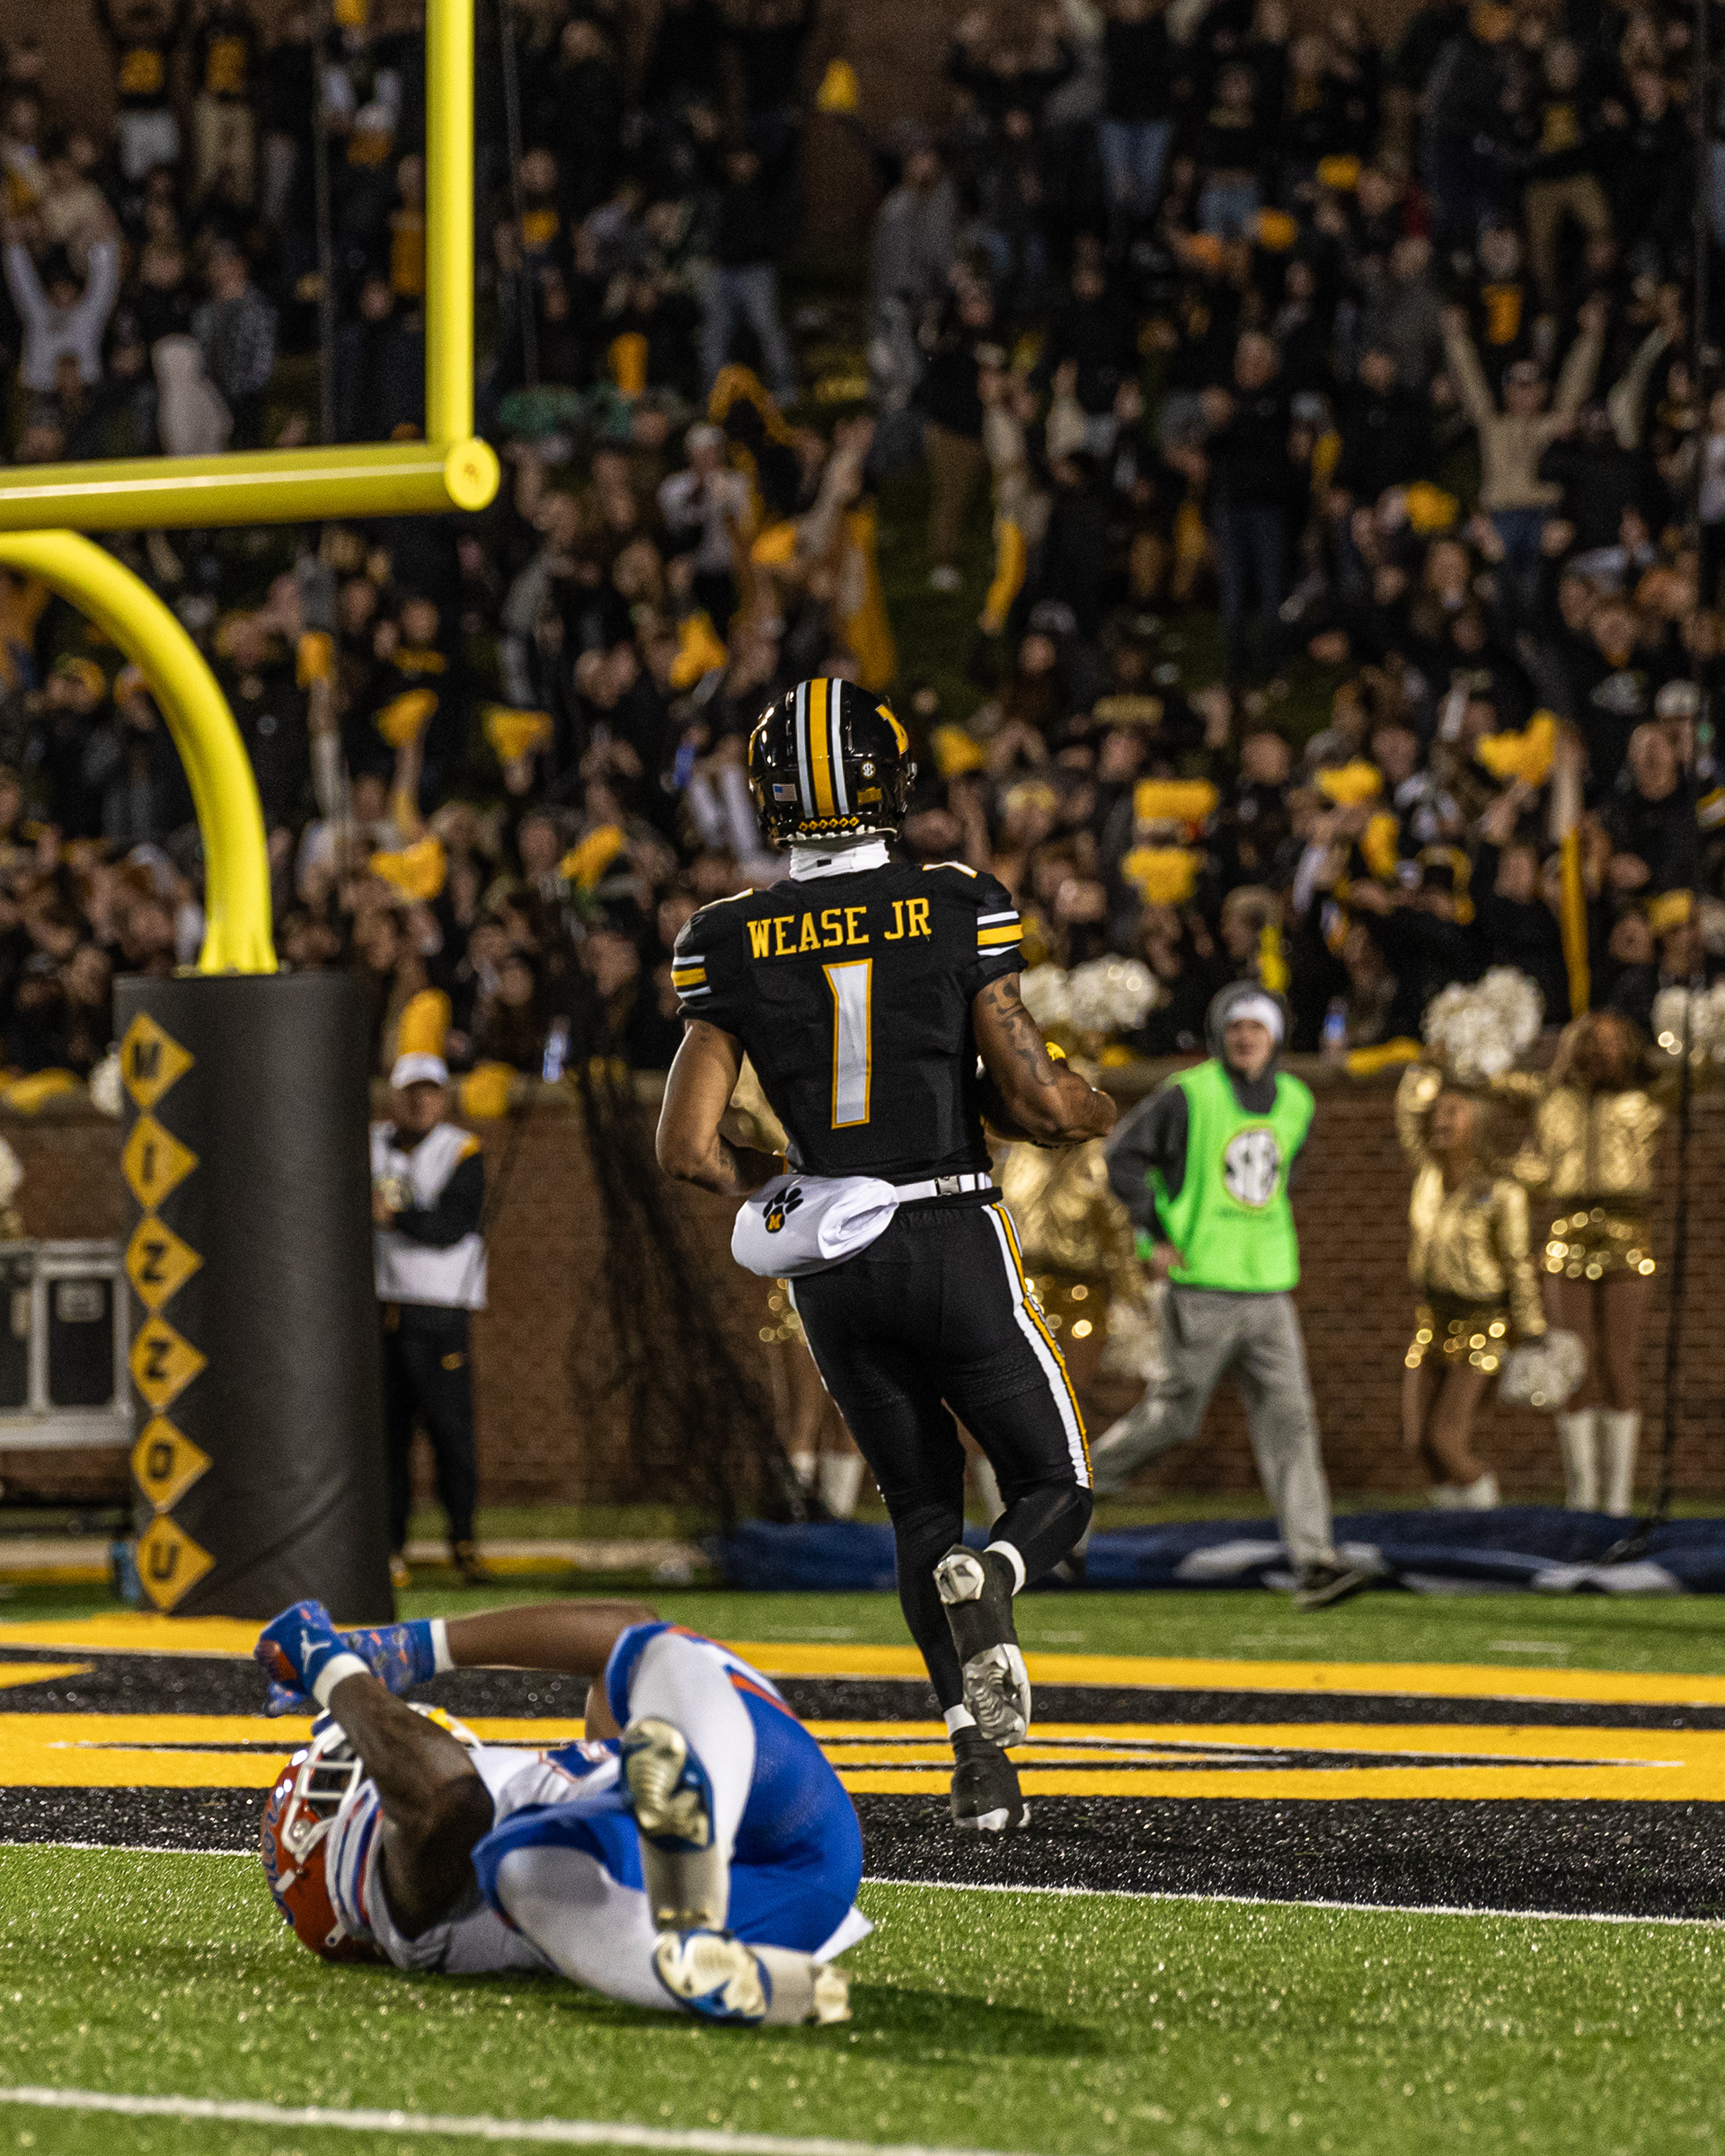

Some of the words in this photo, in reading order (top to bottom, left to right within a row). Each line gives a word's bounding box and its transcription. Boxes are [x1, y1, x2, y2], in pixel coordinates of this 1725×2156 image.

[747, 906, 870, 959] WEASE
[884, 897, 932, 941] JR
[821, 958, 873, 1130] 1
